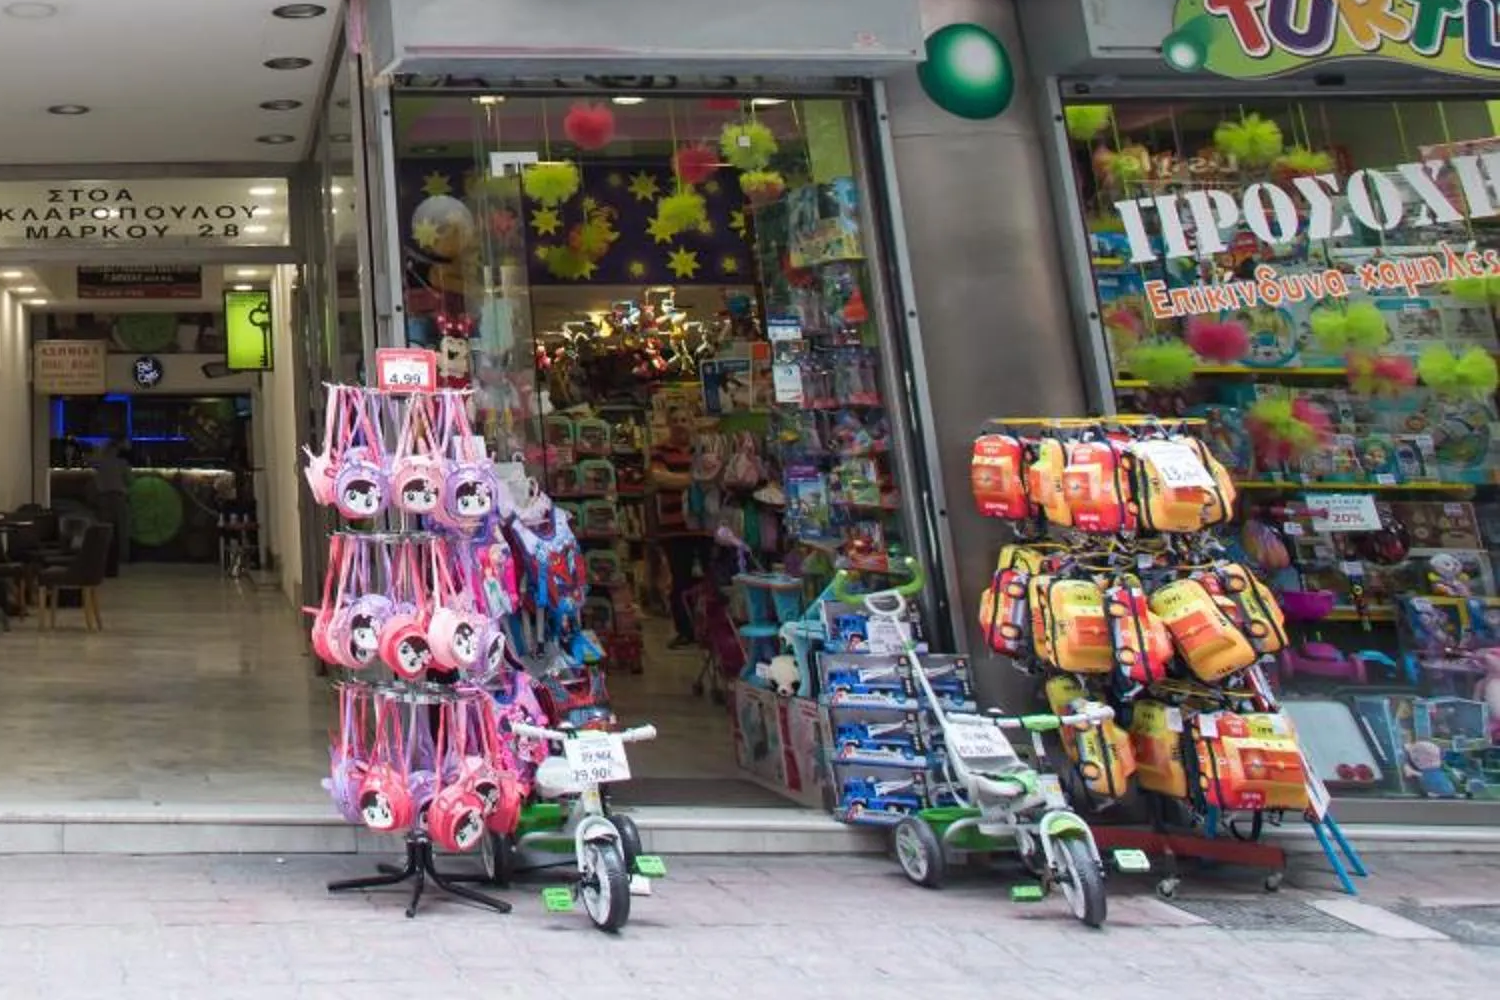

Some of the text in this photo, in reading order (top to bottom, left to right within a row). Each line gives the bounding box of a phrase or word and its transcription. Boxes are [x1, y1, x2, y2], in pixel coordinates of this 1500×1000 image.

[47, 188, 133, 203] ΣΤΟΑ
[1114, 151, 1500, 263] ΠΡΟΣΟΧΗ
[25, 224, 170, 240] ΜΑΡΚΟΥ
[199, 224, 240, 238] 28
